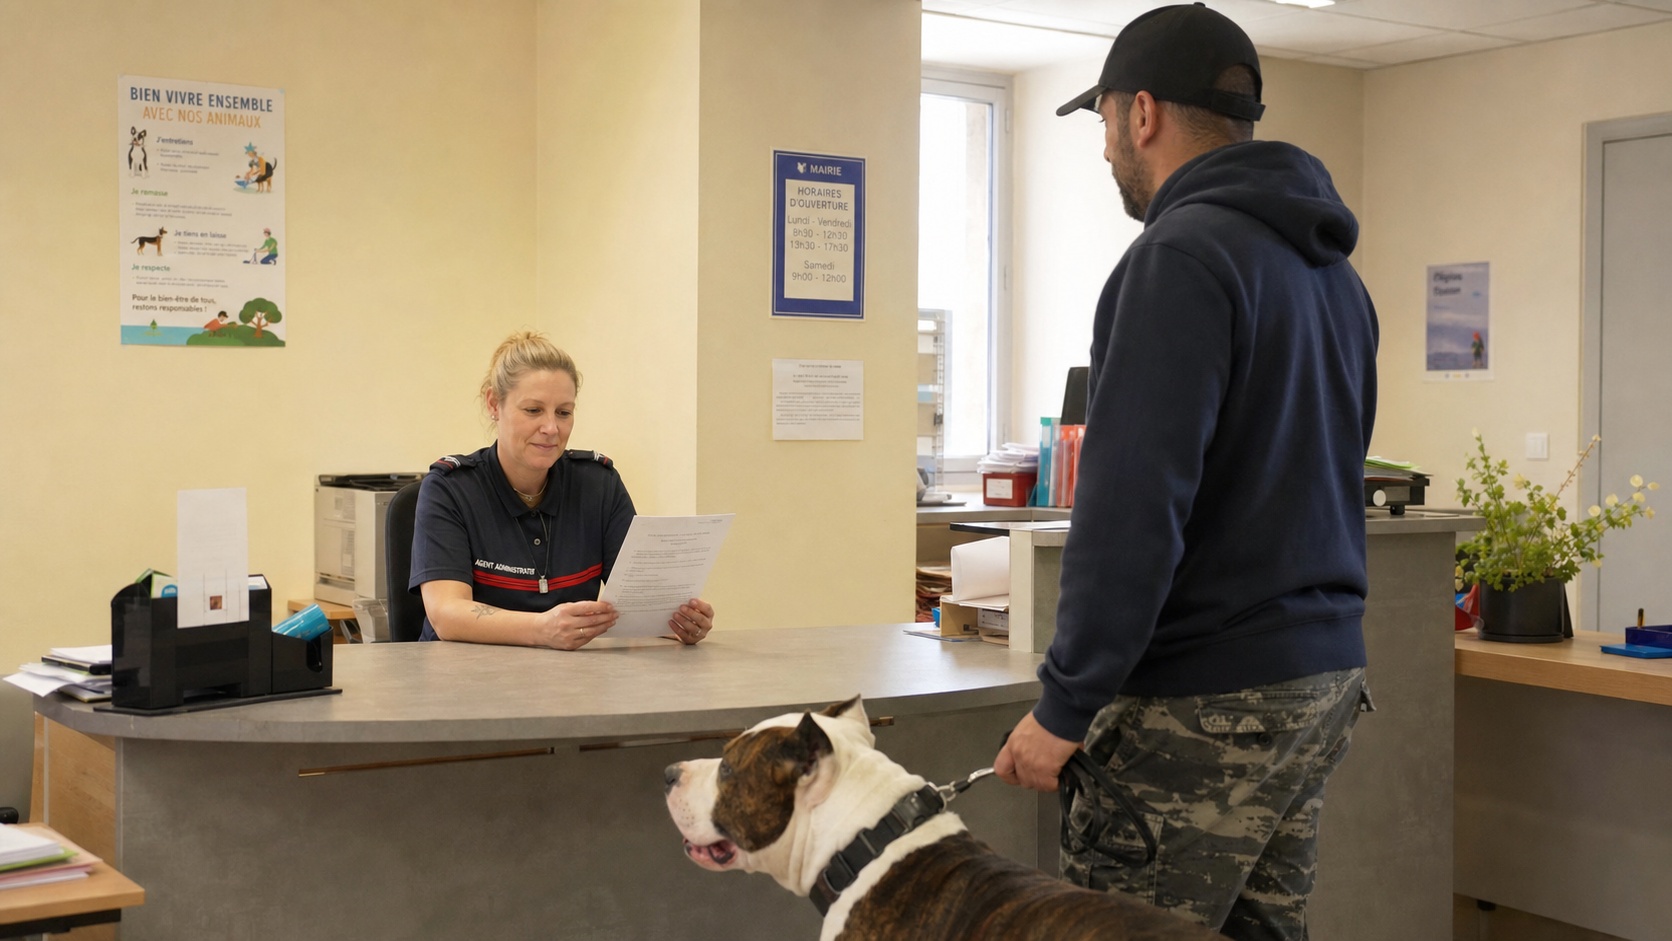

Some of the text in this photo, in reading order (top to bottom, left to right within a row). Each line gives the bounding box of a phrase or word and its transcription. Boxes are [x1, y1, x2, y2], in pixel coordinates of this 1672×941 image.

[130, 86, 273, 112] BIEN VIVRE ENSEMBLE
[143, 106, 261, 128] AVEC NOS ANIMAUX
[810, 164, 842, 176] MAIRIE
[131, 188, 139, 196] Je
[798, 186, 842, 198] HORAIRES
[790, 198, 849, 211] D'OUVERTURE
[787, 216, 810, 225] Lundi
[817, 217, 852, 228] Vendredi
[824, 242, 849, 252] 17h30
[804, 260, 835, 270] Samedi
[792, 272, 813, 281] 9h00
[822, 274, 847, 283] 12h00
[158, 295, 188, 303] bien-être
[474, 559, 494, 569] AGENT
